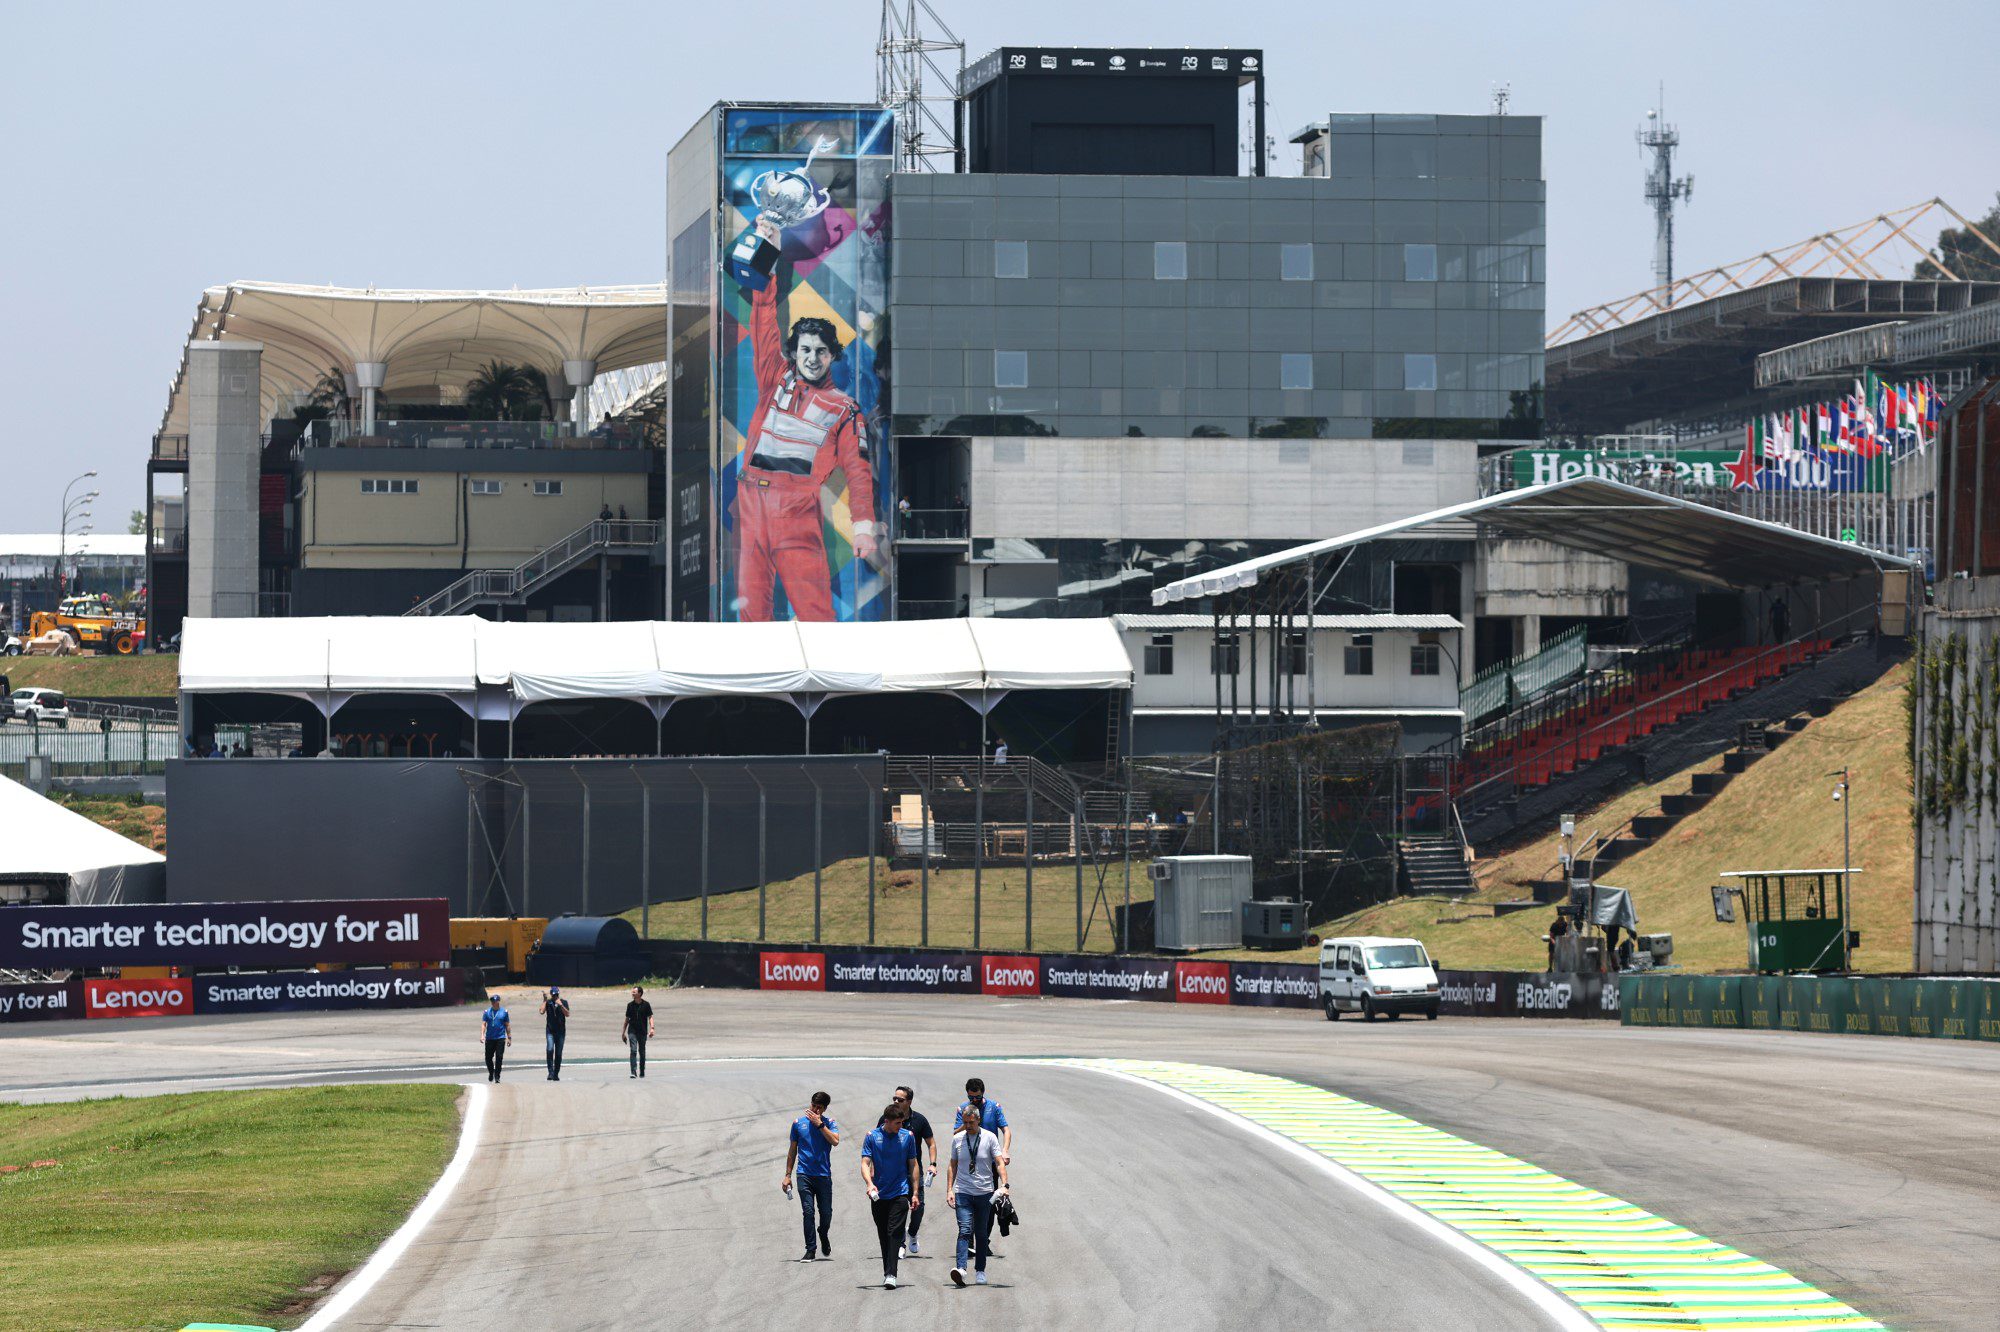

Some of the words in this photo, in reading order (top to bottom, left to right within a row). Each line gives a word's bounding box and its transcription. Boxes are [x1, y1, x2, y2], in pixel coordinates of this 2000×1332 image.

[22, 921, 145, 948] Smarter
[154, 916, 328, 949] technology
[334, 915, 380, 943] for
[385, 913, 419, 942] all
[1760, 935, 1776, 947] 10
[765, 960, 819, 982] Lenovo
[834, 963, 876, 981] Smarter
[879, 964, 940, 985] technology
[942, 964, 960, 981] for
[960, 965, 972, 982] all
[986, 964, 1035, 986] Lenovo
[1048, 968, 1088, 986] Smarter
[1088, 969, 1142, 992] technology
[1142, 970, 1157, 989] for
[1157, 971, 1169, 989] all
[1179, 970, 1227, 994] Lenovo
[208, 984, 281, 1003] Smarter
[287, 979, 390, 999] technology
[394, 978, 422, 996] for
[424, 977, 445, 994] all
[1235, 974, 1272, 994] Smarter
[1273, 976, 1318, 999] technology
[1441, 982, 1472, 1005] chnology
[1473, 982, 1485, 1002] for
[1486, 982, 1496, 1002] all
[1516, 981, 1571, 1009] #BrazilGP
[17, 992, 45, 1009] for
[47, 990, 67, 1009] all
[91, 988, 183, 1009] Lenovo
